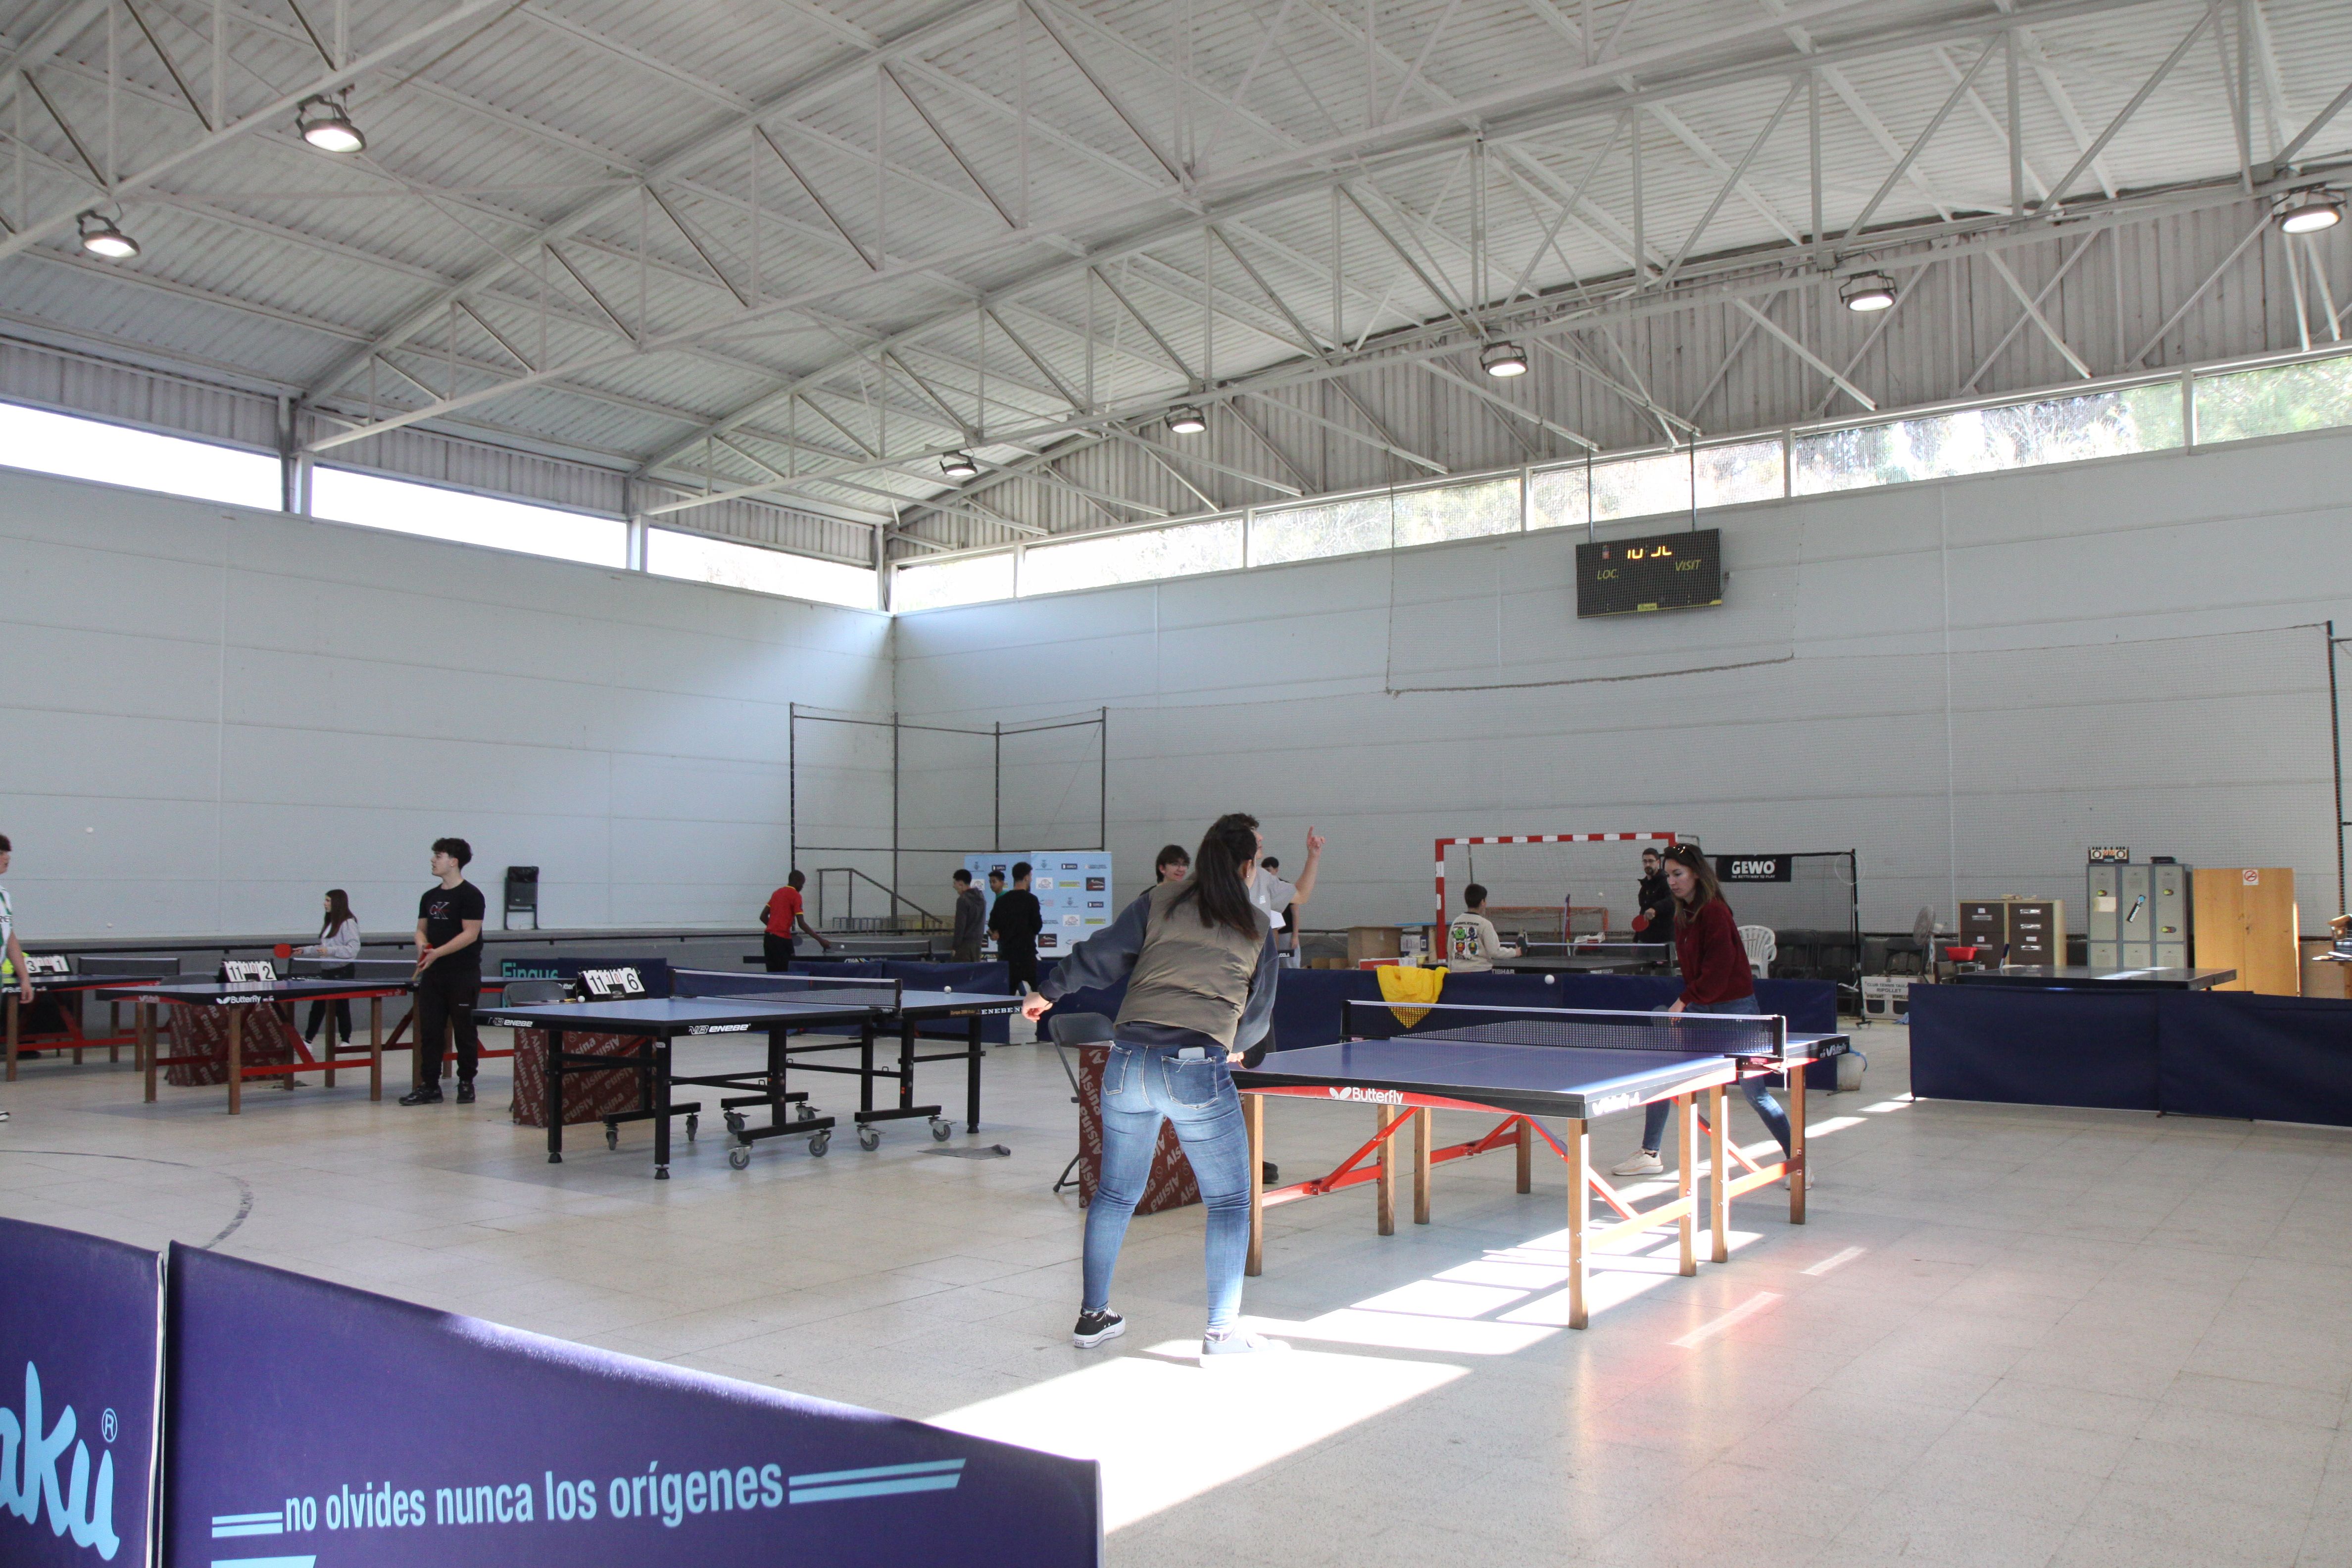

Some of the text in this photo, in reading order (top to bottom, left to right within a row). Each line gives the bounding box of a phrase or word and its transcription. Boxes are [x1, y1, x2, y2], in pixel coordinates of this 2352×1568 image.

[1675, 559, 1702, 571] VISIT
[1597, 569, 1619, 580] LOC.
[1732, 860, 1775, 874] GEWO
[229, 967, 243, 980] 11
[263, 966, 273, 979] 2
[589, 975, 607, 992] 11
[627, 973, 639, 990] 6
[231, 995, 261, 1004] Butterfly
[1352, 1087, 1404, 1105] Butterfly
[1150, 1172, 1179, 1212] Alsina
[286, 1461, 784, 1531] no olvides nunca los orígenes
